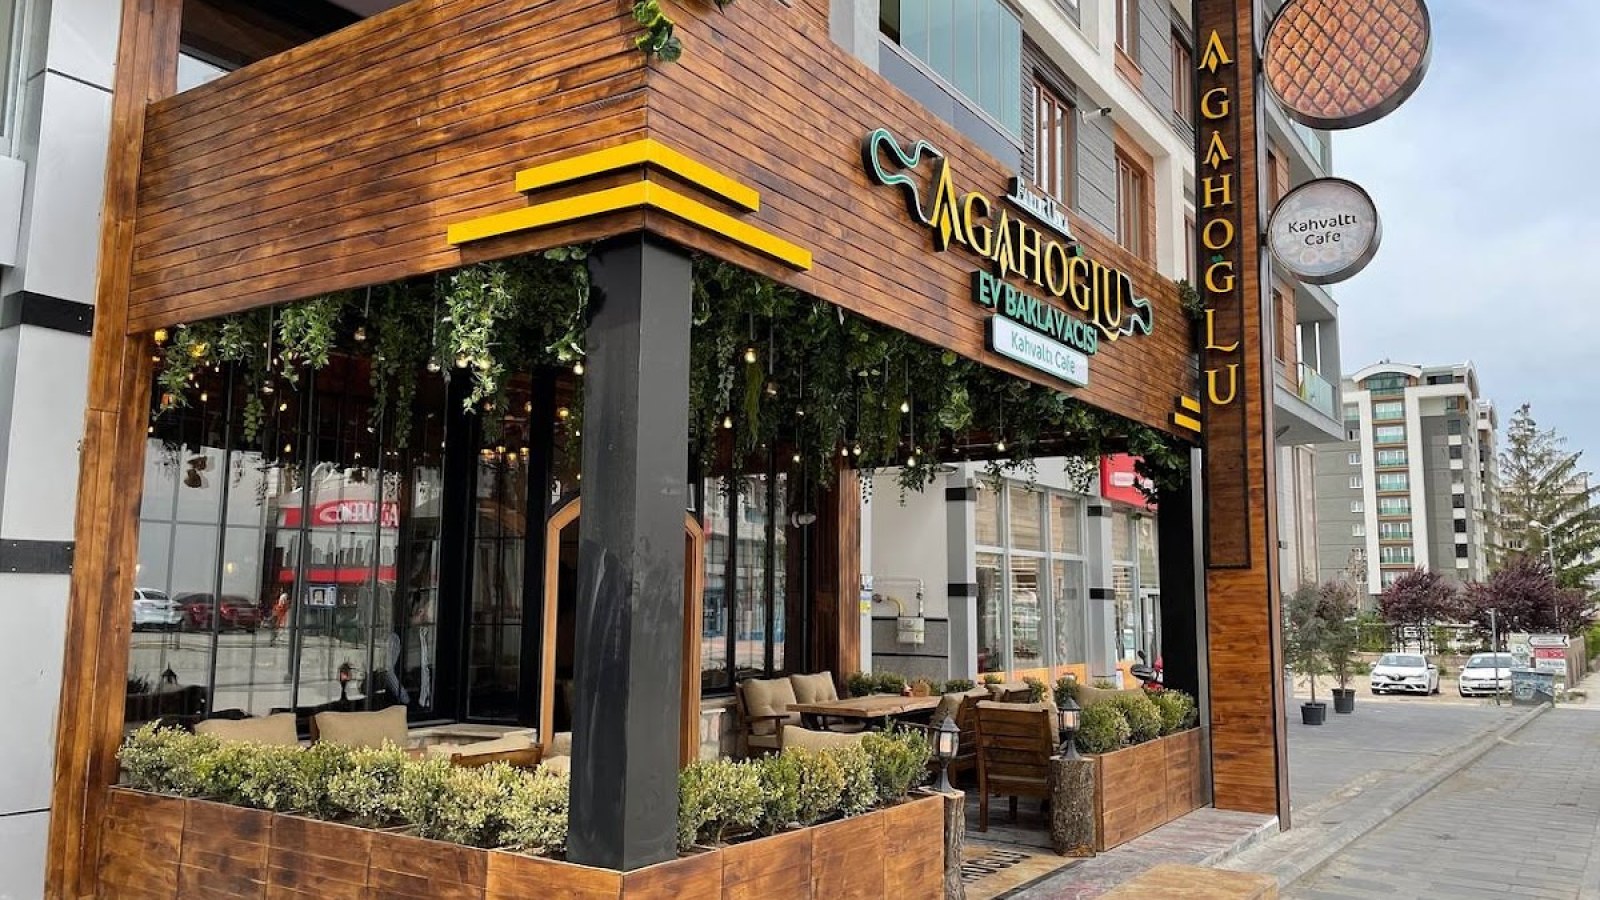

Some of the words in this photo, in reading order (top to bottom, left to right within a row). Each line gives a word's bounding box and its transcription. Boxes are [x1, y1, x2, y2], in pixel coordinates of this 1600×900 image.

[1288, 213, 1357, 233] Kahvaltı
[1304, 231, 1341, 246] Cafe
[979, 269, 1001, 309] EV
[1004, 282, 1098, 354] BAKLAVACISI
[1011, 330, 1053, 366] Kahvaltı
[1054, 351, 1076, 375] Cafe
